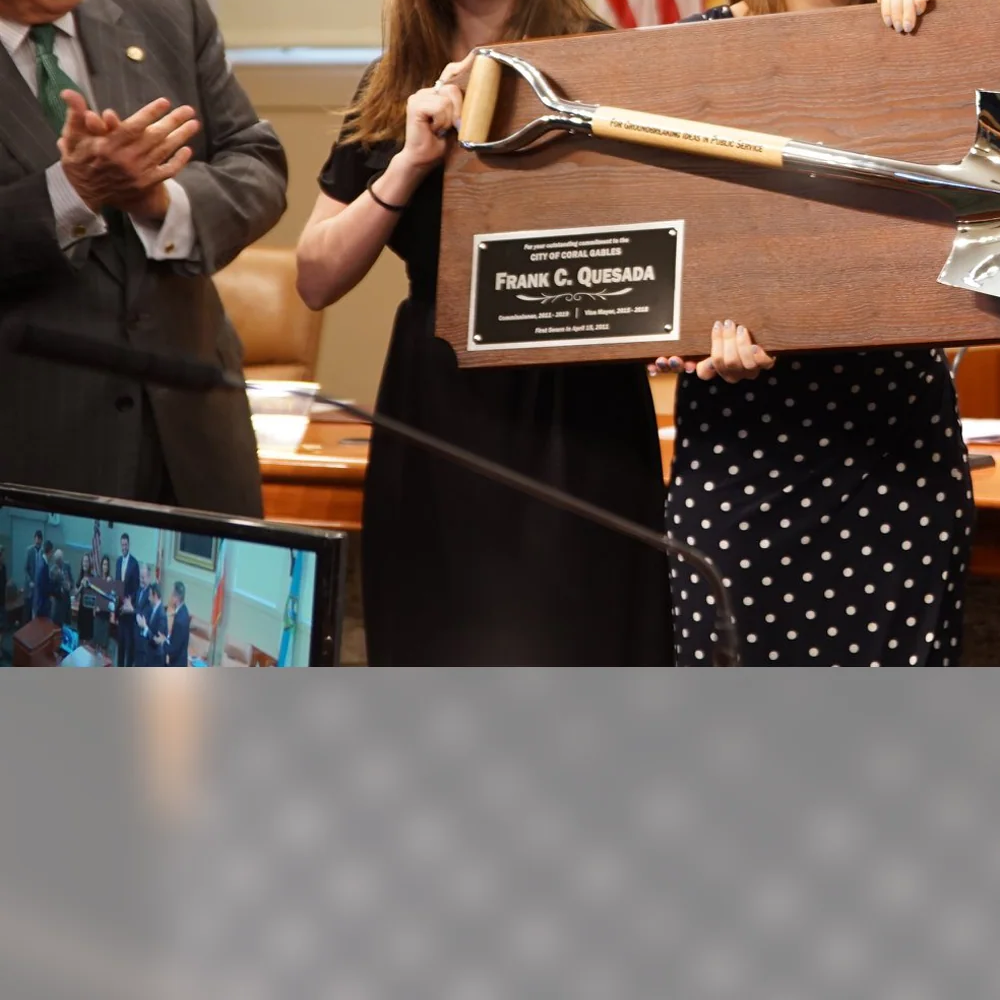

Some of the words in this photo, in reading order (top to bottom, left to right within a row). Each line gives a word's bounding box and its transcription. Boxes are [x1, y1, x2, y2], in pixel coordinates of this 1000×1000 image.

[610, 117, 622, 128] FOR
[624, 120, 681, 138] GROUNDBREAKING
[682, 132, 701, 142] IDEAS
[710, 134, 735, 148] PUBLIC
[735, 139, 763, 153] SERVICE
[546, 240, 578, 249] outstanding
[578, 238, 612, 246] commitment
[619, 236, 630, 244] the
[530, 252, 549, 262] CITY
[549, 251, 560, 260] OF
[561, 249, 589, 259] CORAL
[589, 247, 622, 258] GABLES
[494, 271, 550, 291] FRANK
[553, 267, 573, 287] C.
[576, 265, 656, 288] QUESADA
